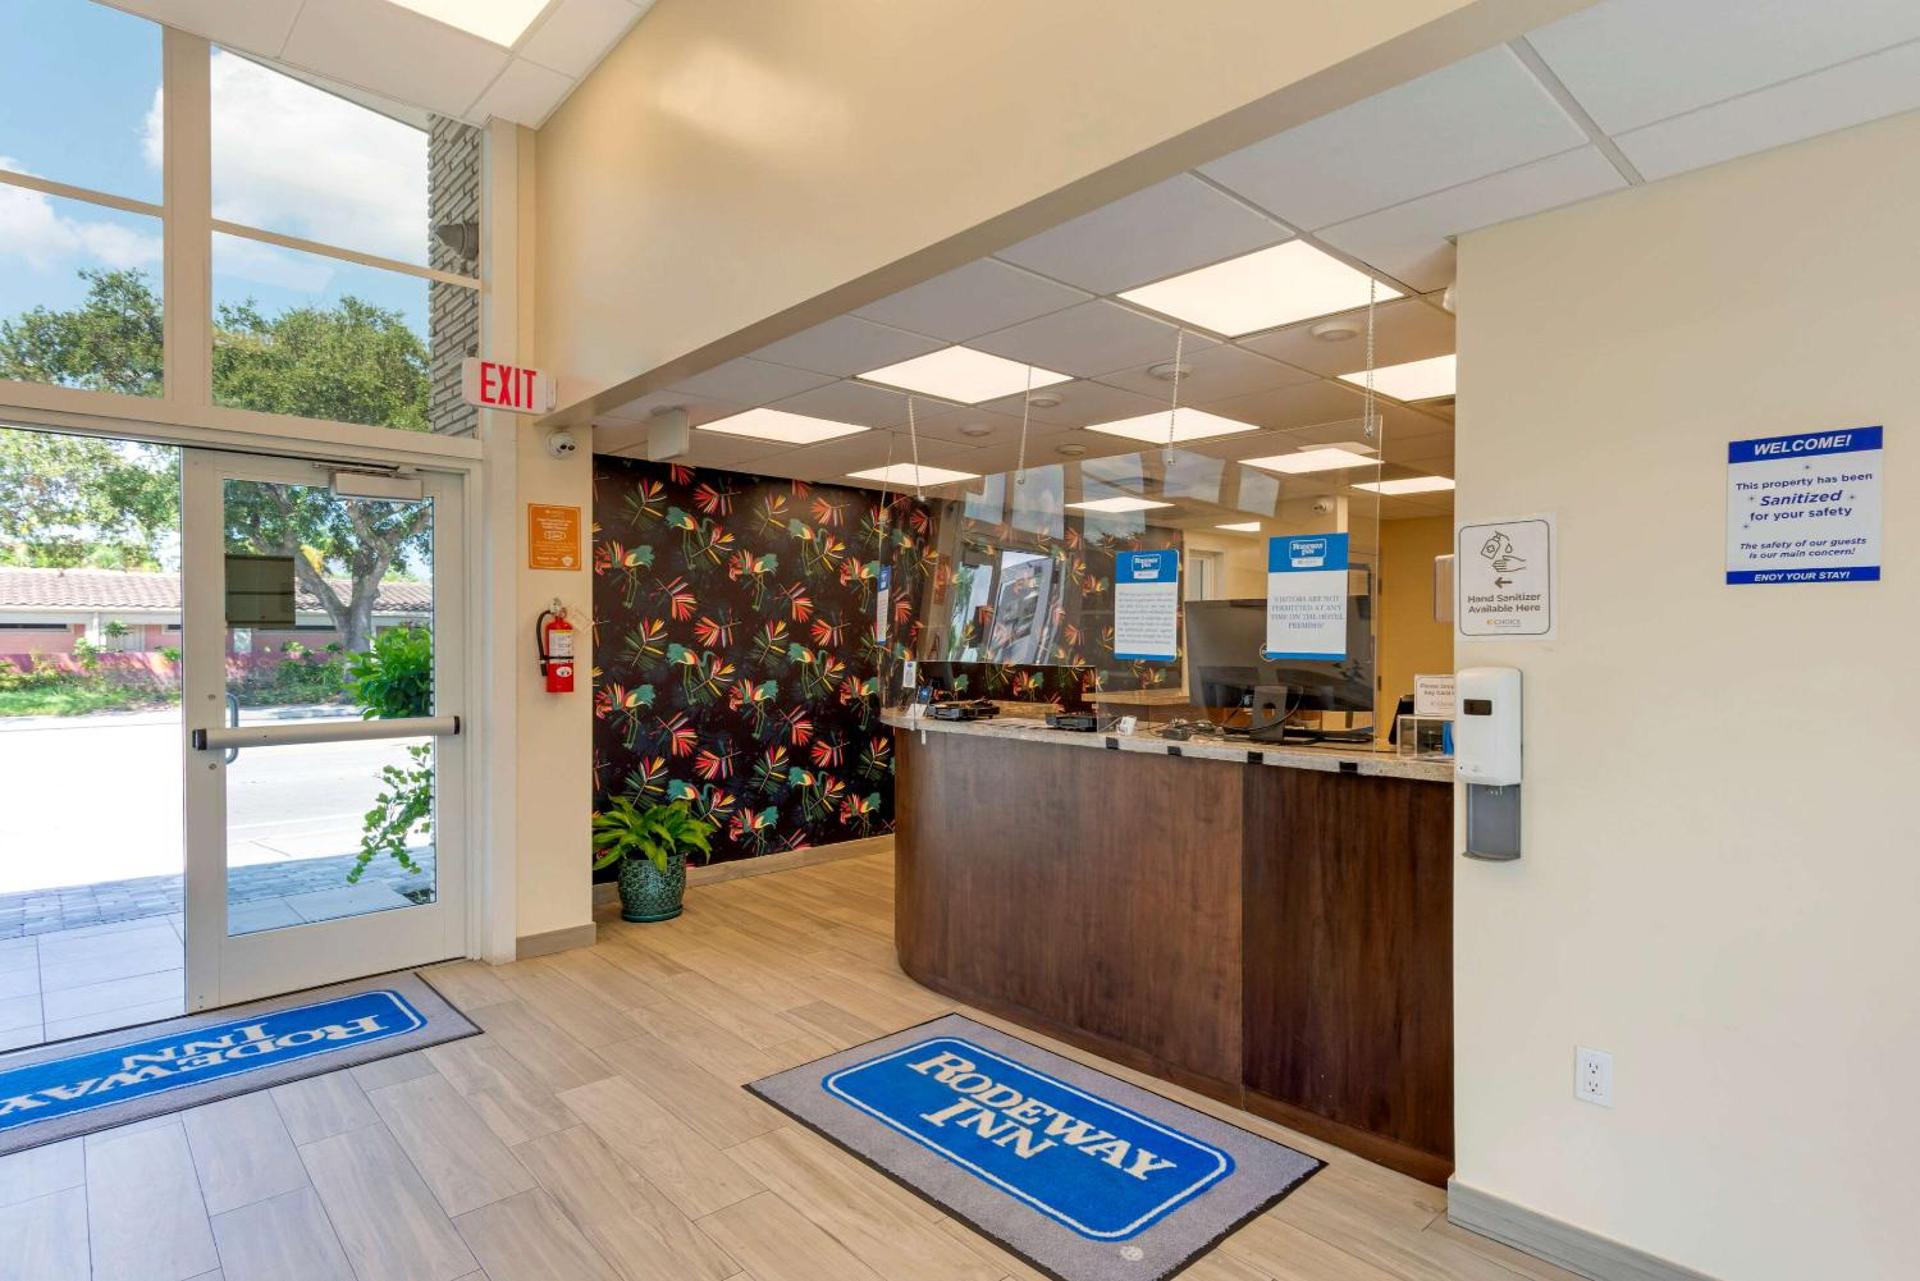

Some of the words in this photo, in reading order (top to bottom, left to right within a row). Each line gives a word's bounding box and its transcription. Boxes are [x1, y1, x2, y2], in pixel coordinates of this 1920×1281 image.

[480, 361, 537, 409] EXIT
[1754, 434, 1852, 456] WELCOME!
[1736, 482, 1759, 491] This
[1762, 476, 1813, 489] property
[1817, 475, 1838, 484] has
[1841, 471, 1873, 482] been
[1760, 489, 1843, 507] Sanitized
[1750, 511, 1768, 521] for
[1773, 510, 1805, 522] your
[1808, 506, 1853, 518] safety
[1740, 543, 1758, 551] The
[1760, 541, 1792, 550] safety
[1795, 539, 1807, 548] of
[1809, 539, 1828, 547] our
[1830, 537, 1867, 547] guests
[1780, 550, 1806, 558] main
[1809, 547, 1856, 557] concern!
[1754, 573, 1784, 582] ENOY
[1786, 572, 1816, 581] YOUR
[1818, 571, 1851, 580] STAY!
[1467, 594, 1494, 603] Hand
[1496, 592, 1541, 602] Sanitizer
[1468, 604, 1514, 614] Available
[1516, 603, 1541, 612] Here
[122, 1022, 278, 1071] INN
[0, 1014, 390, 1116] RODEWAY
[906, 1050, 1177, 1181] RODEWAY
[919, 1096, 1060, 1162] INN
